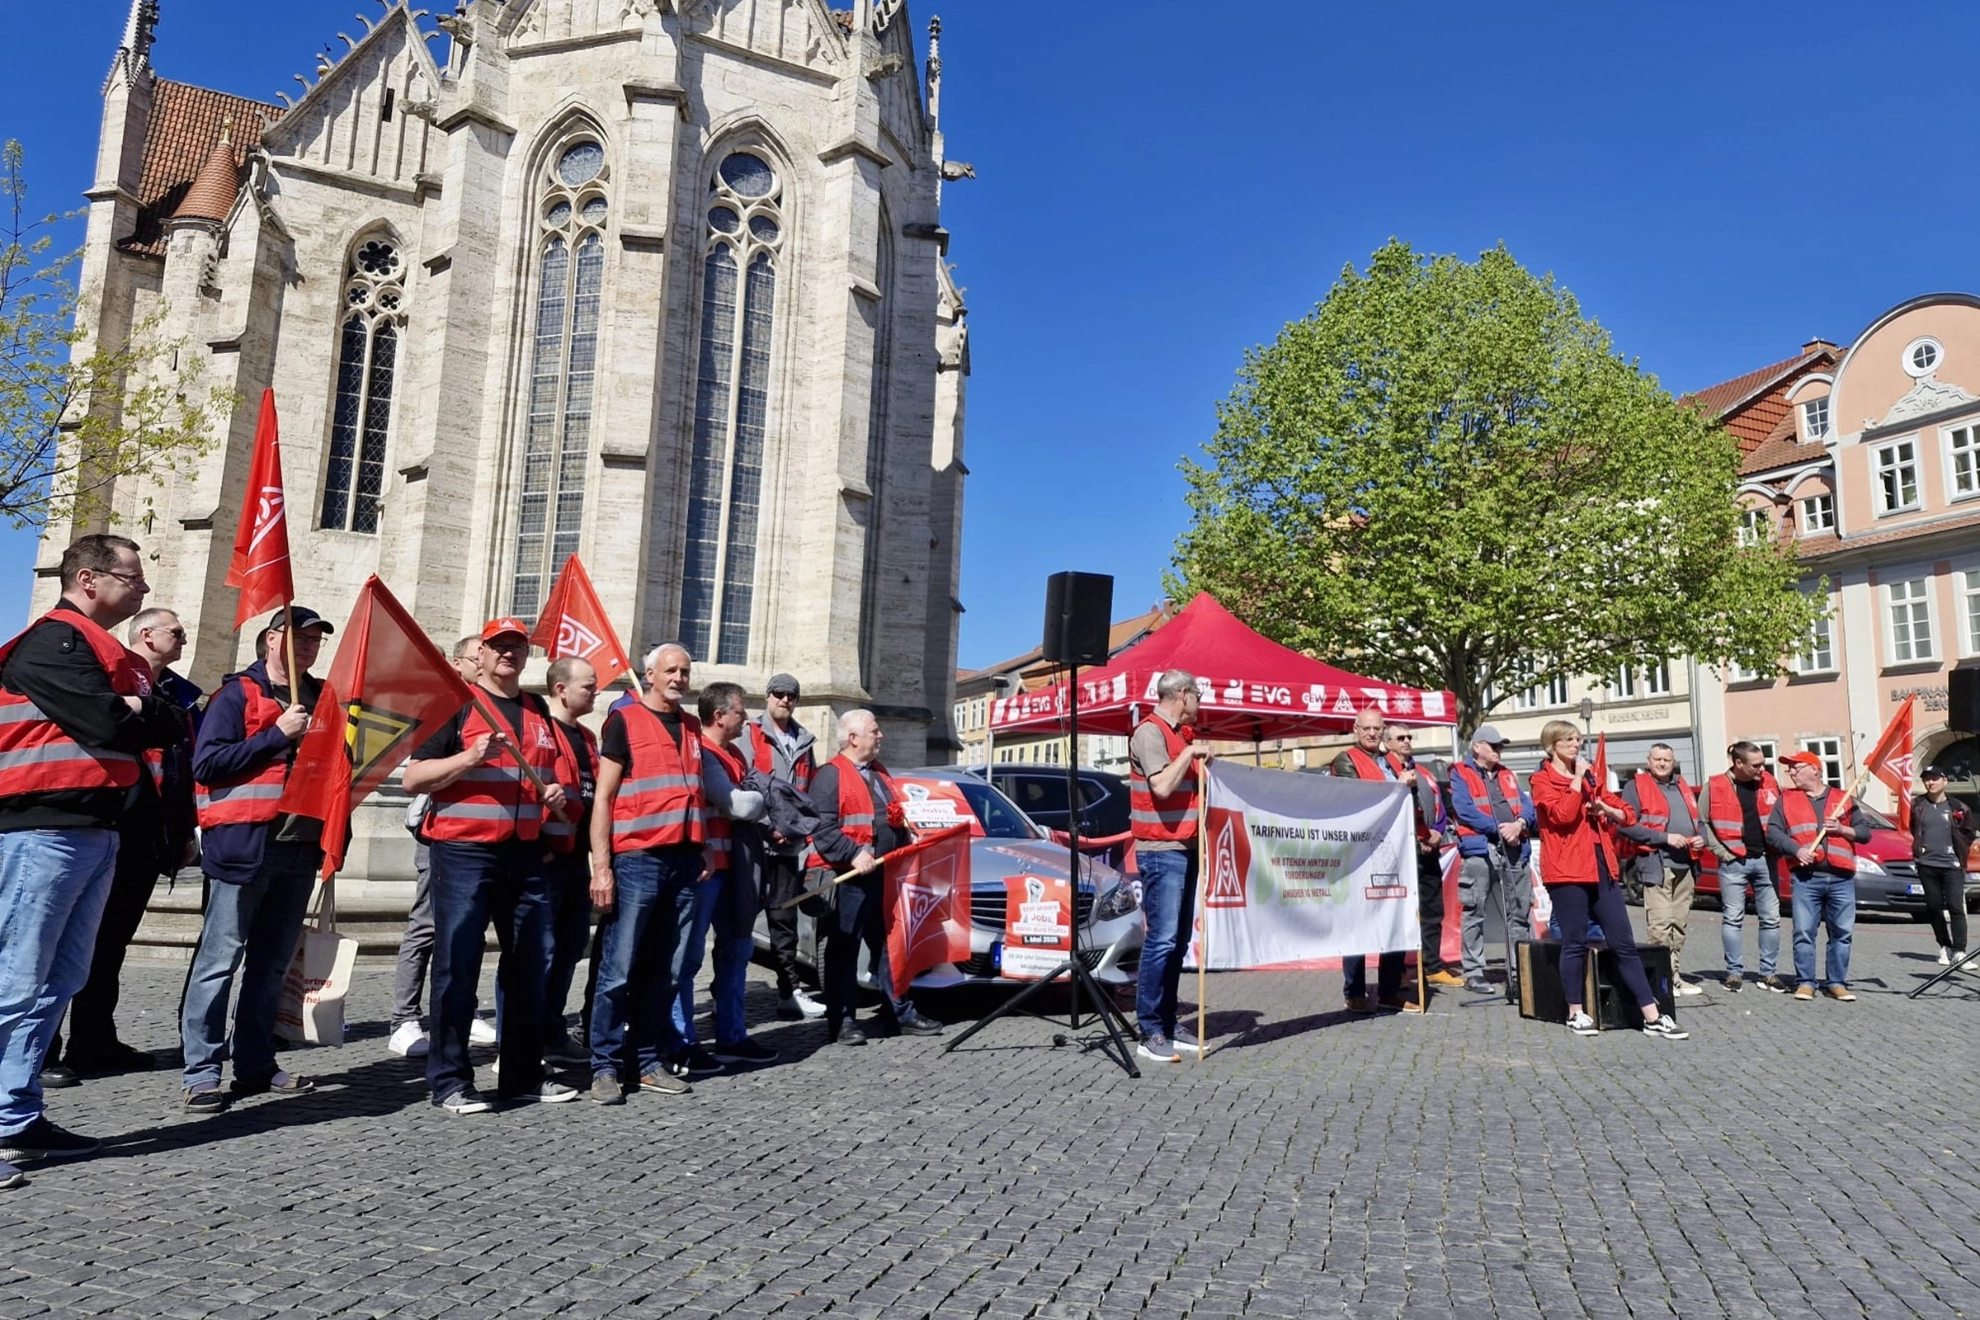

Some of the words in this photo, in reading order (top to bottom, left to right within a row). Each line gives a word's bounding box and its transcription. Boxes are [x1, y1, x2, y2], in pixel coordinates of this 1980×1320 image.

[1251, 684, 1291, 705] EVG
[1302, 692, 1326, 704] GEW
[1250, 824, 1306, 840] TARIFNIVEAU
[1308, 829, 1319, 841] IST
[1321, 830, 1349, 842] UNSER
[1271, 857, 1281, 866] WIR
[1282, 857, 1306, 867] STEHEN
[1307, 858, 1329, 868] HINTER
[1330, 858, 1341, 867] DEN
[1284, 871, 1326, 880] FORDERUNGEN
[1311, 888, 1332, 897] METALL
[1031, 914, 1055, 924] Jobs,
[1024, 935, 1030, 943] 1.
[1030, 935, 1042, 943] Mai
